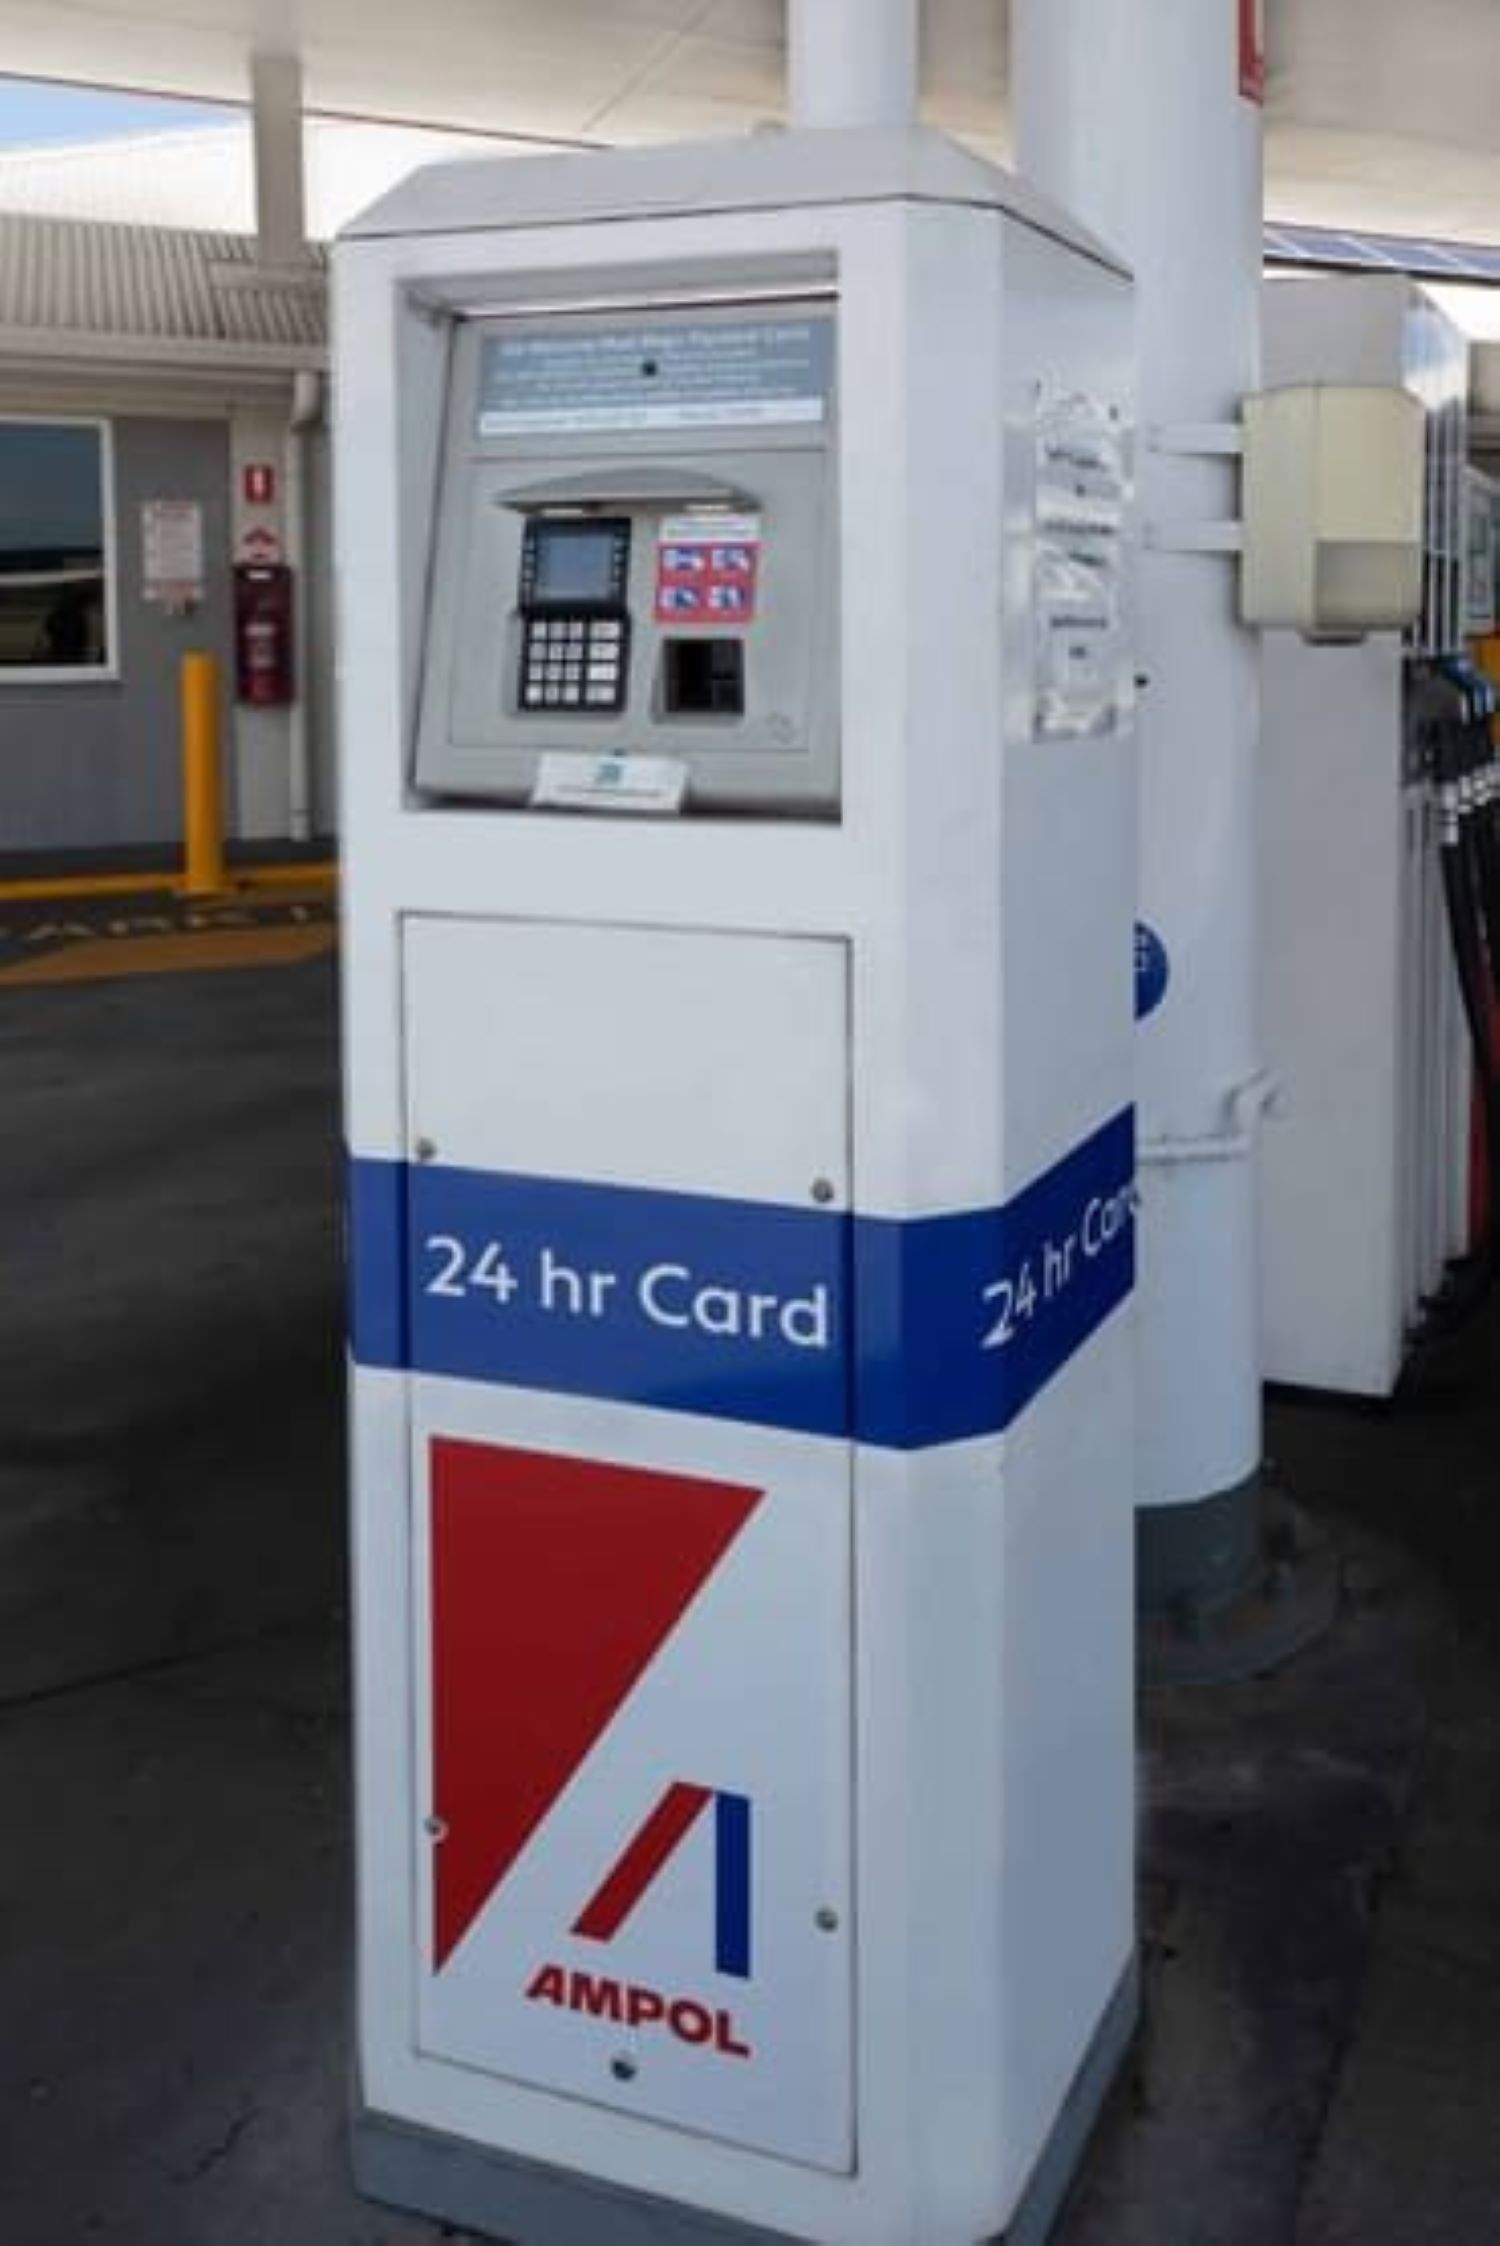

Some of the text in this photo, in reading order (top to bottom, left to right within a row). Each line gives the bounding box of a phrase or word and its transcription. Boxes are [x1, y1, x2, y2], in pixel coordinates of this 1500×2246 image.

[426, 1235, 828, 1348] 24 hr Card
[981, 1279, 1036, 1348] 24
[1043, 1236, 1076, 1297] hr
[526, 1964, 751, 2058] AMPOL
